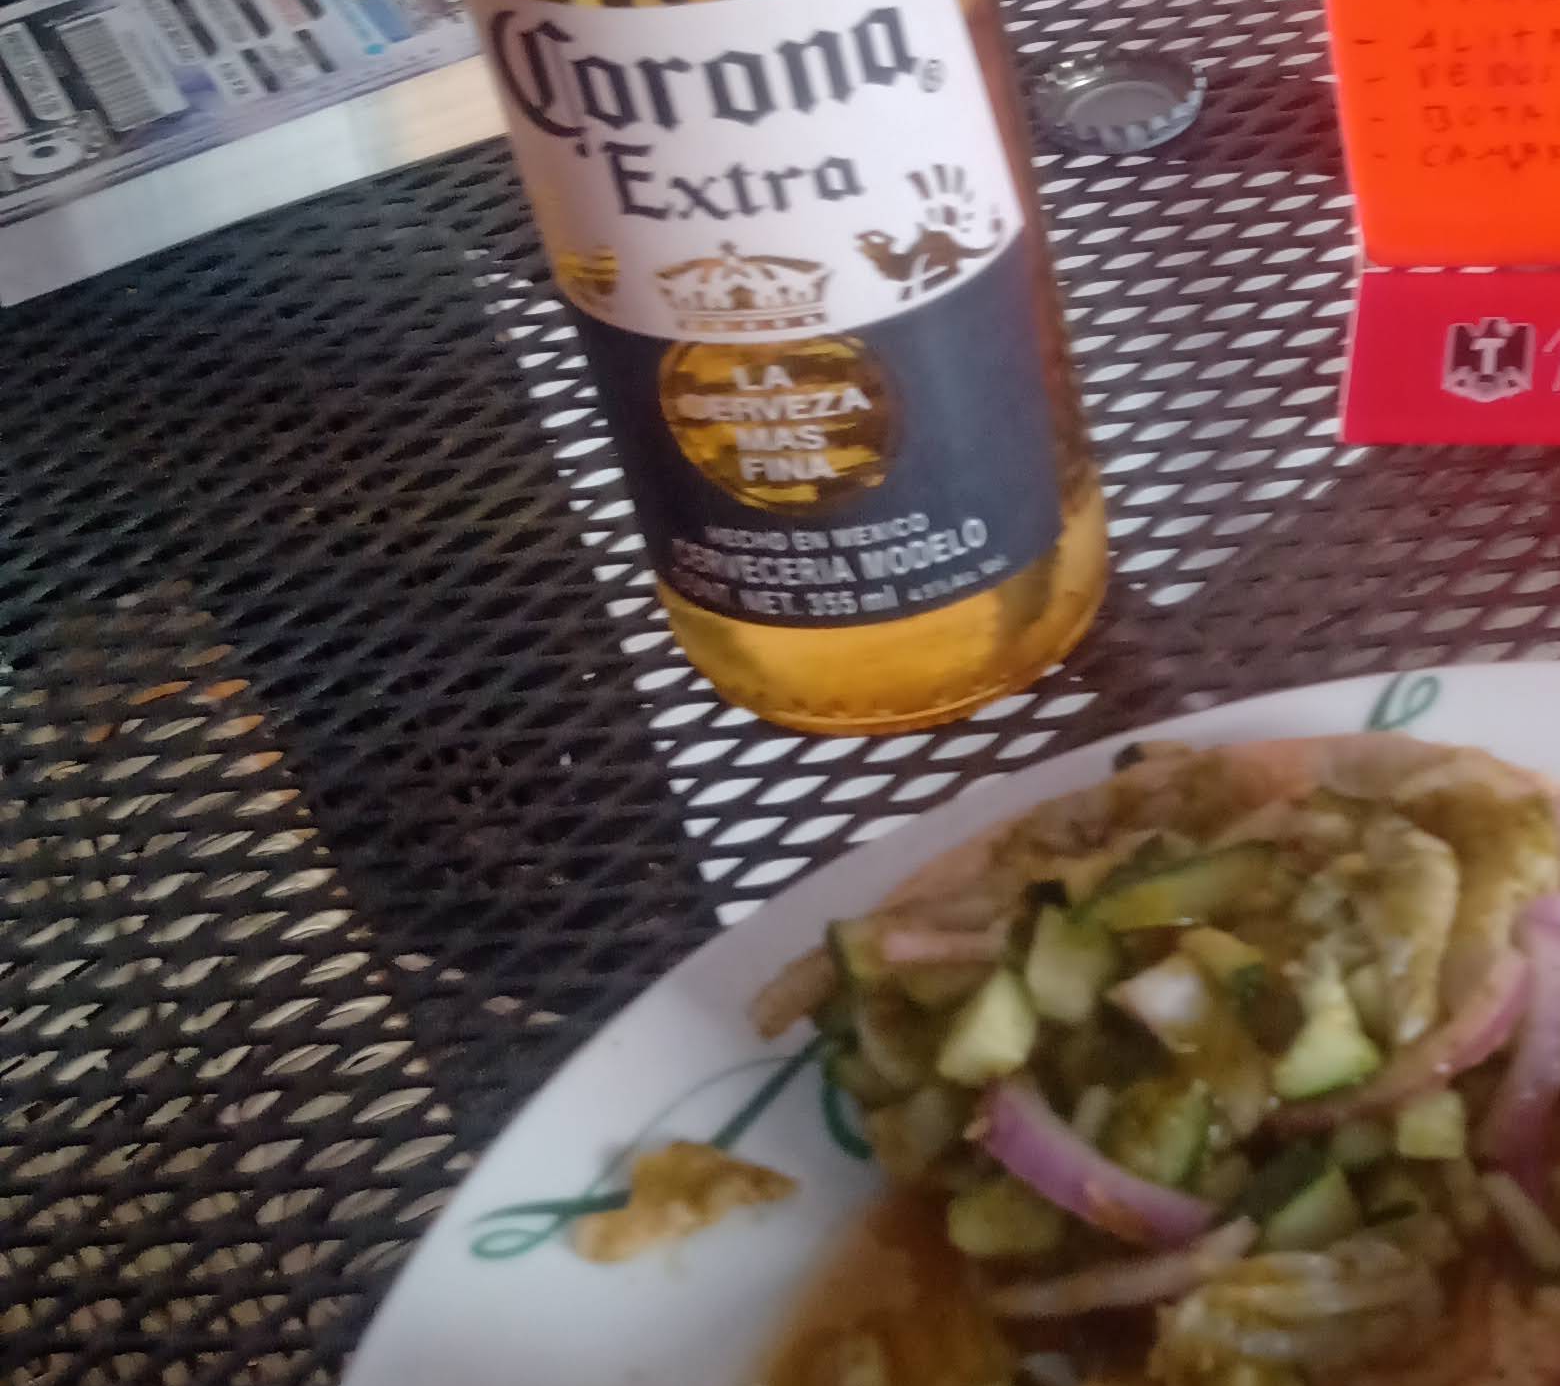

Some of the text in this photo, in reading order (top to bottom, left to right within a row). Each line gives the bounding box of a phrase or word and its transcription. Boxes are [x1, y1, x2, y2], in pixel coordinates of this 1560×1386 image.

[490, 6, 919, 157] Corona
[600, 141, 866, 221] Extra
[732, 365, 795, 392] LA
